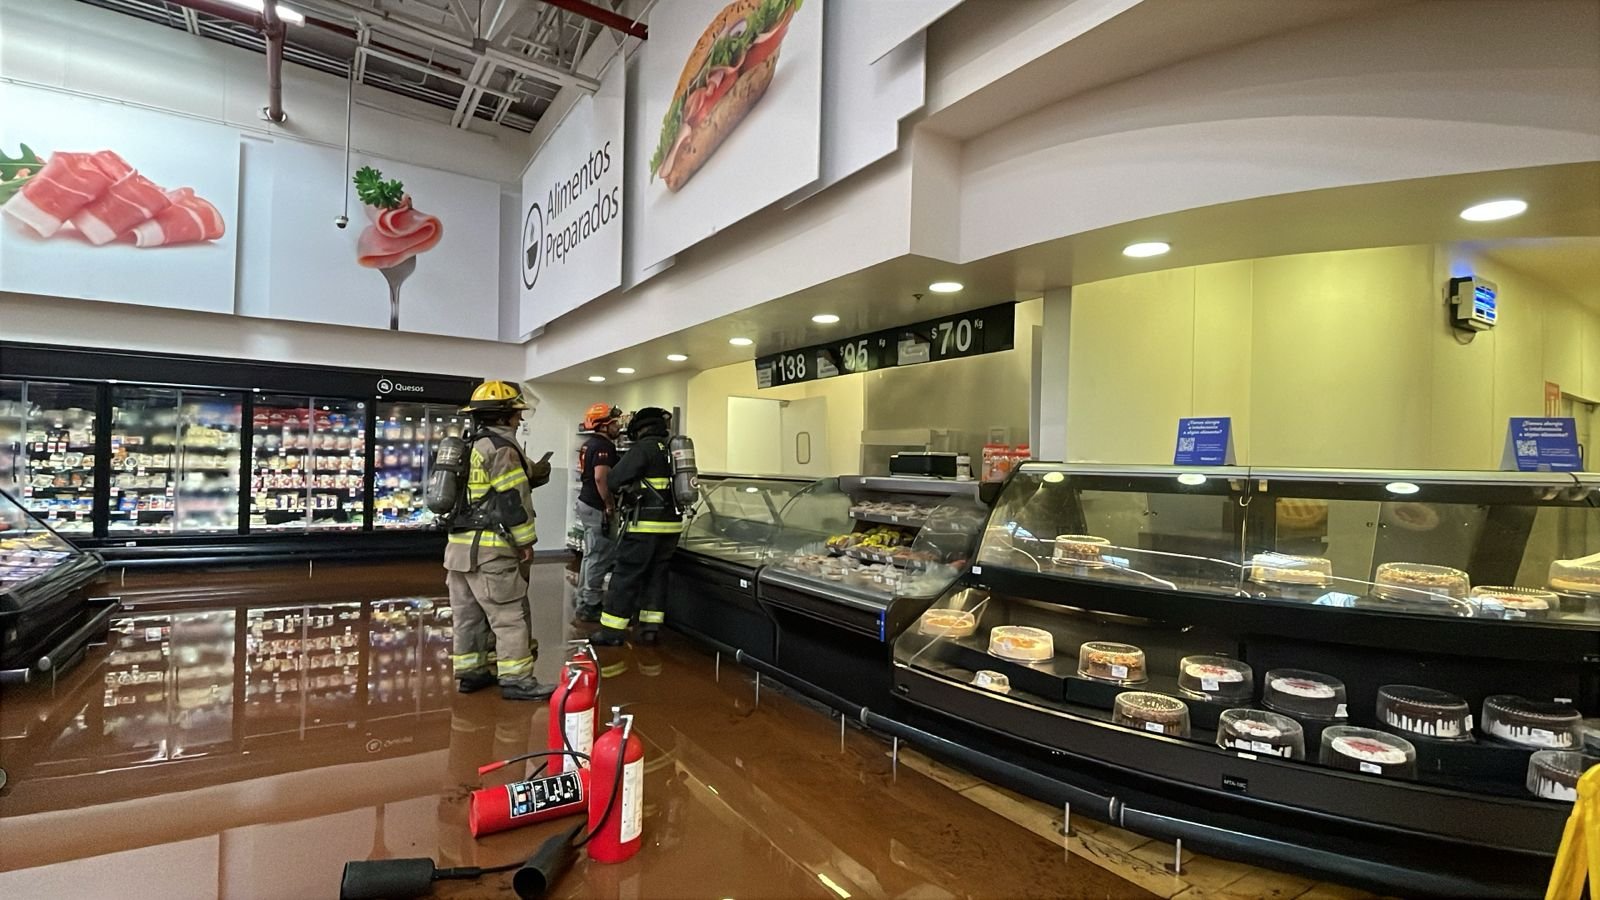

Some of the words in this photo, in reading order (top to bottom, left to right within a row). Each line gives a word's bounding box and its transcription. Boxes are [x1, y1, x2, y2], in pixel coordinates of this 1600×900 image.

[546, 141, 611, 226] Alimentos
[546, 186, 619, 267] Preparados
[974, 318, 983, 329] Kg
[395, 383, 424, 392] Quesos
